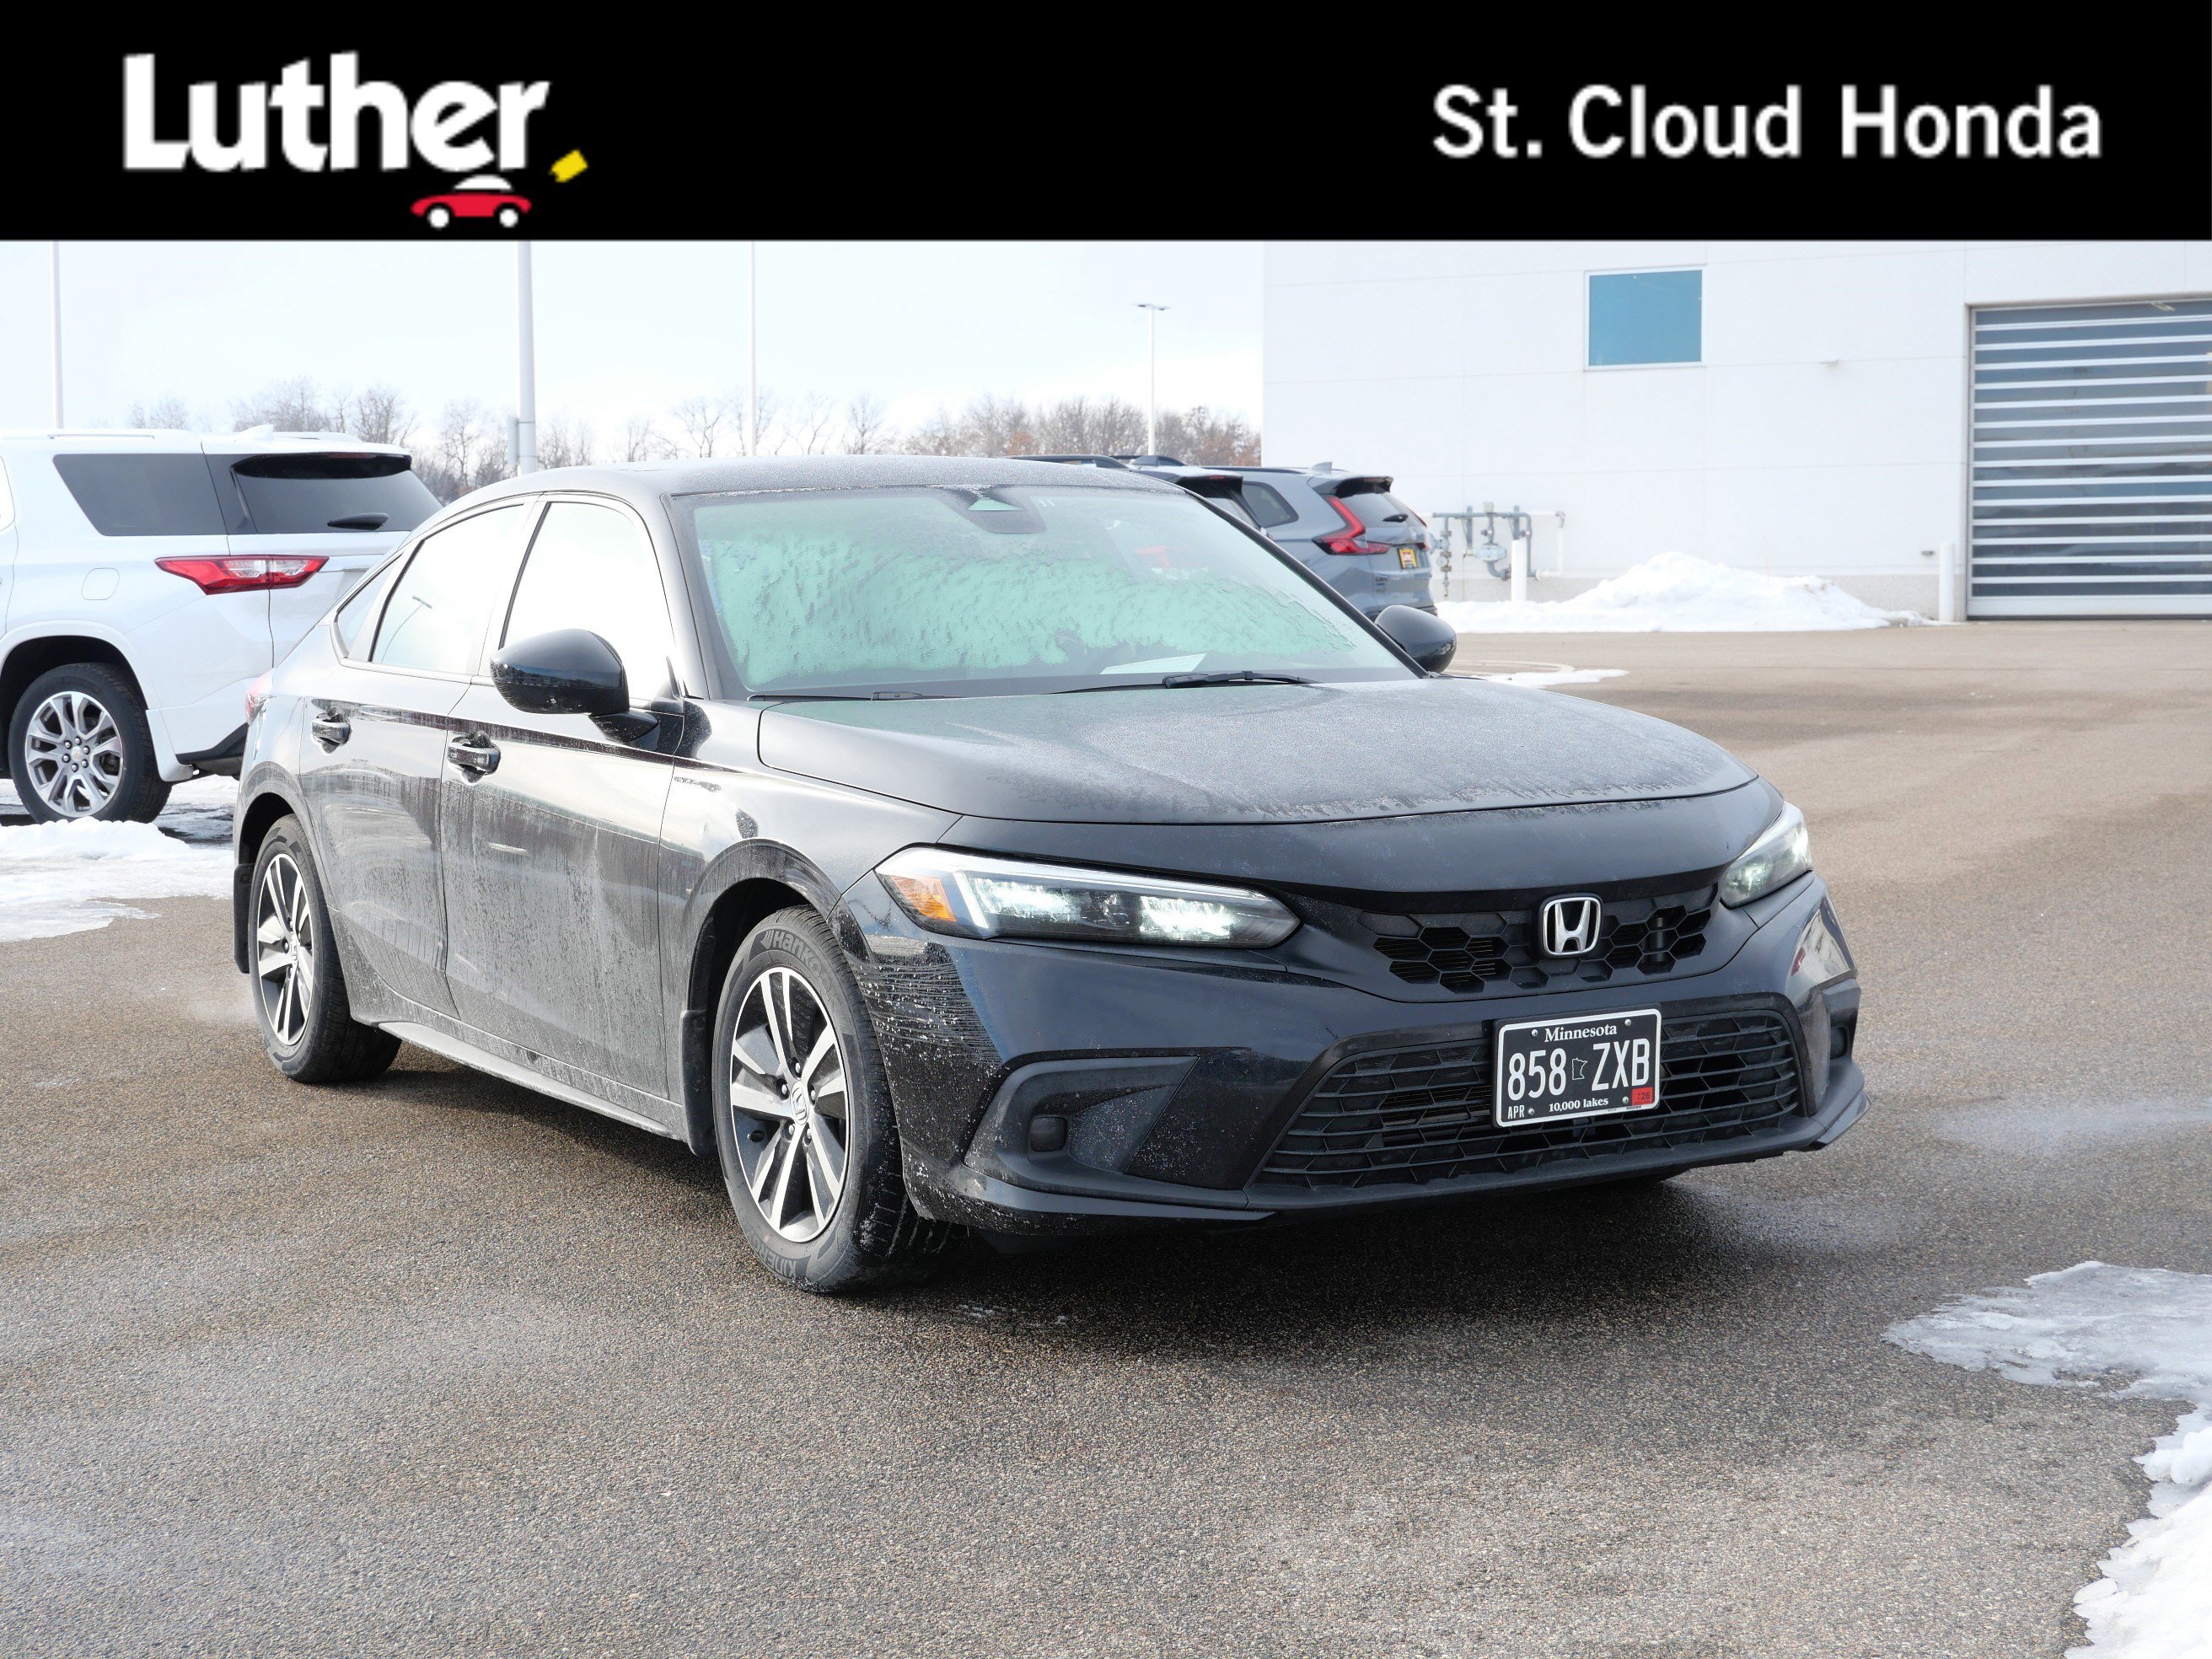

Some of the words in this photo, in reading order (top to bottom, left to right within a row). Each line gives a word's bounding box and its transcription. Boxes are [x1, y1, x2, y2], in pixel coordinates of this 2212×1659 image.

[1544, 1023, 1618, 1043] Minnesota
[1507, 1048, 1567, 1101] 858
[1591, 1038, 1651, 1092] ZXB
[1507, 1104, 1525, 1119] APR
[1549, 1100, 1581, 1113] 10,000
[1583, 1098, 1609, 1108] lakes
